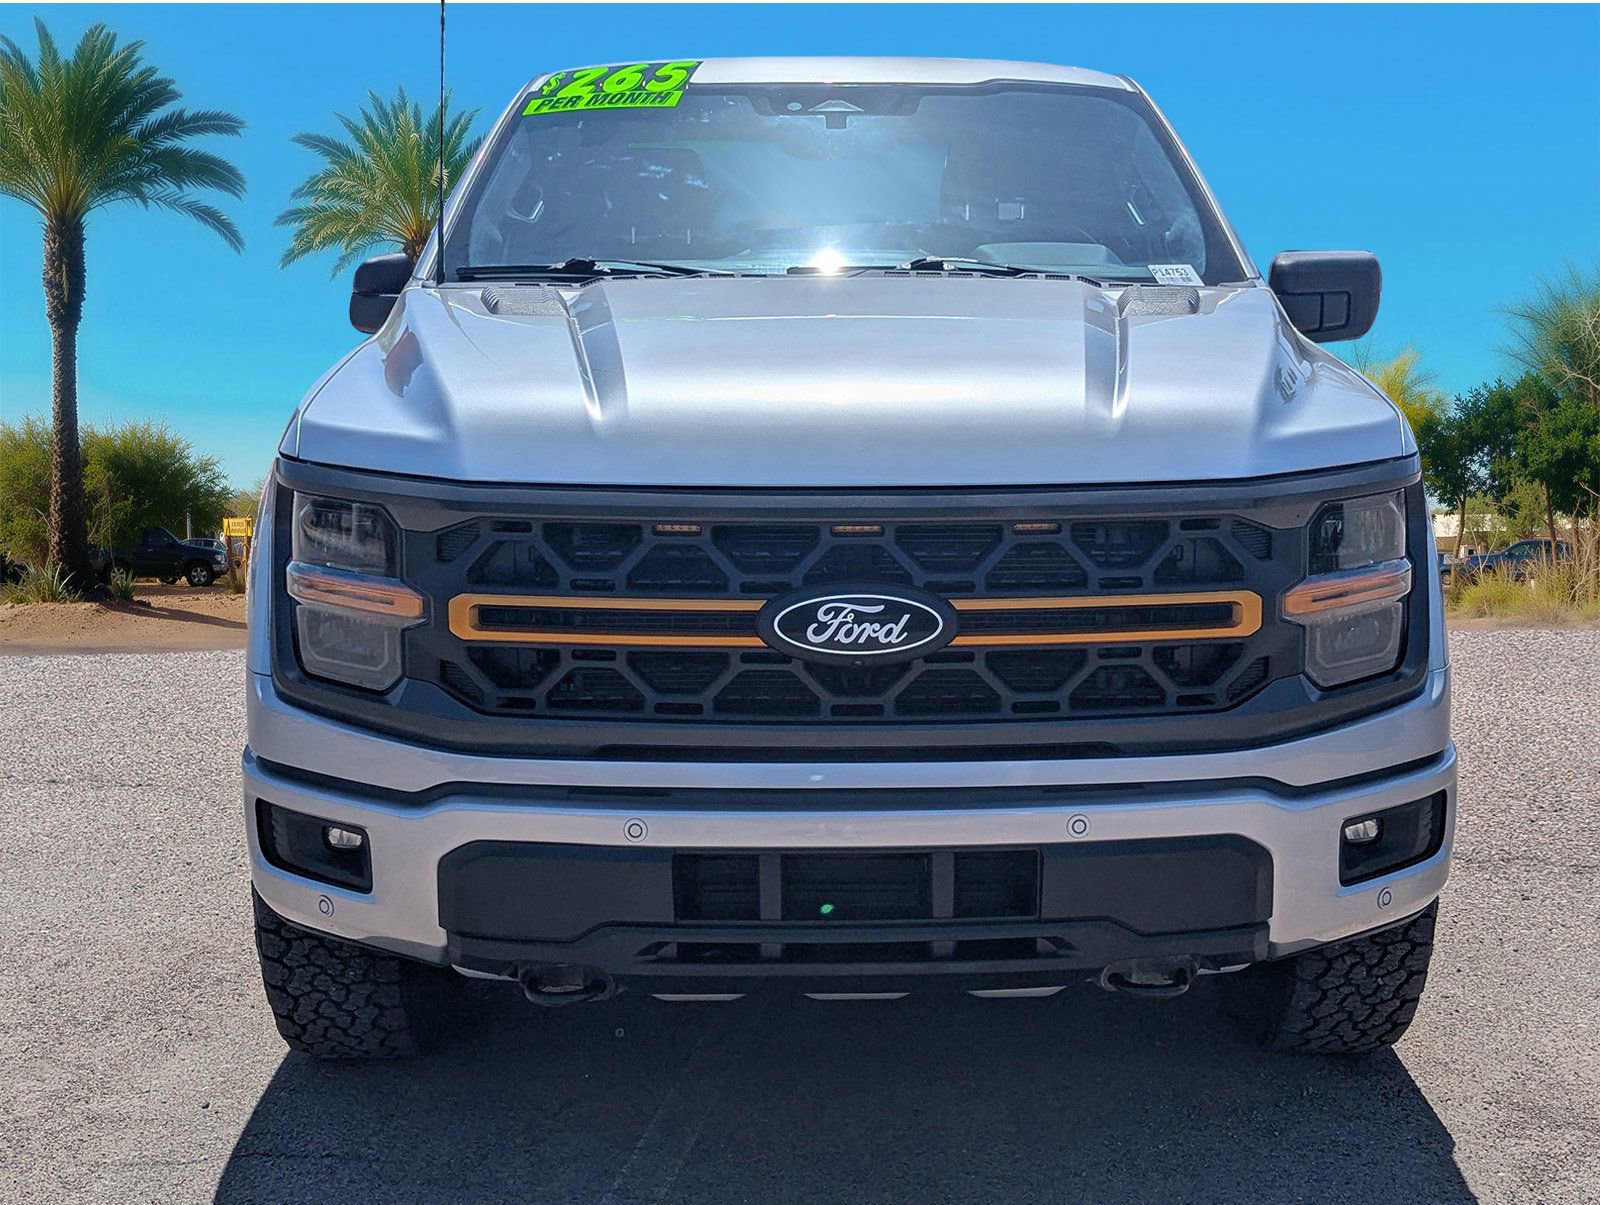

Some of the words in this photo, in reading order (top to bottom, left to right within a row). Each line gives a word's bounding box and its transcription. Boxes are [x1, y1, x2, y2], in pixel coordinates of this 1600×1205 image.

[541, 61, 699, 97] $265
[533, 95, 582, 112] PER
[585, 91, 673, 107] MONTH
[806, 602, 911, 644] Ford
